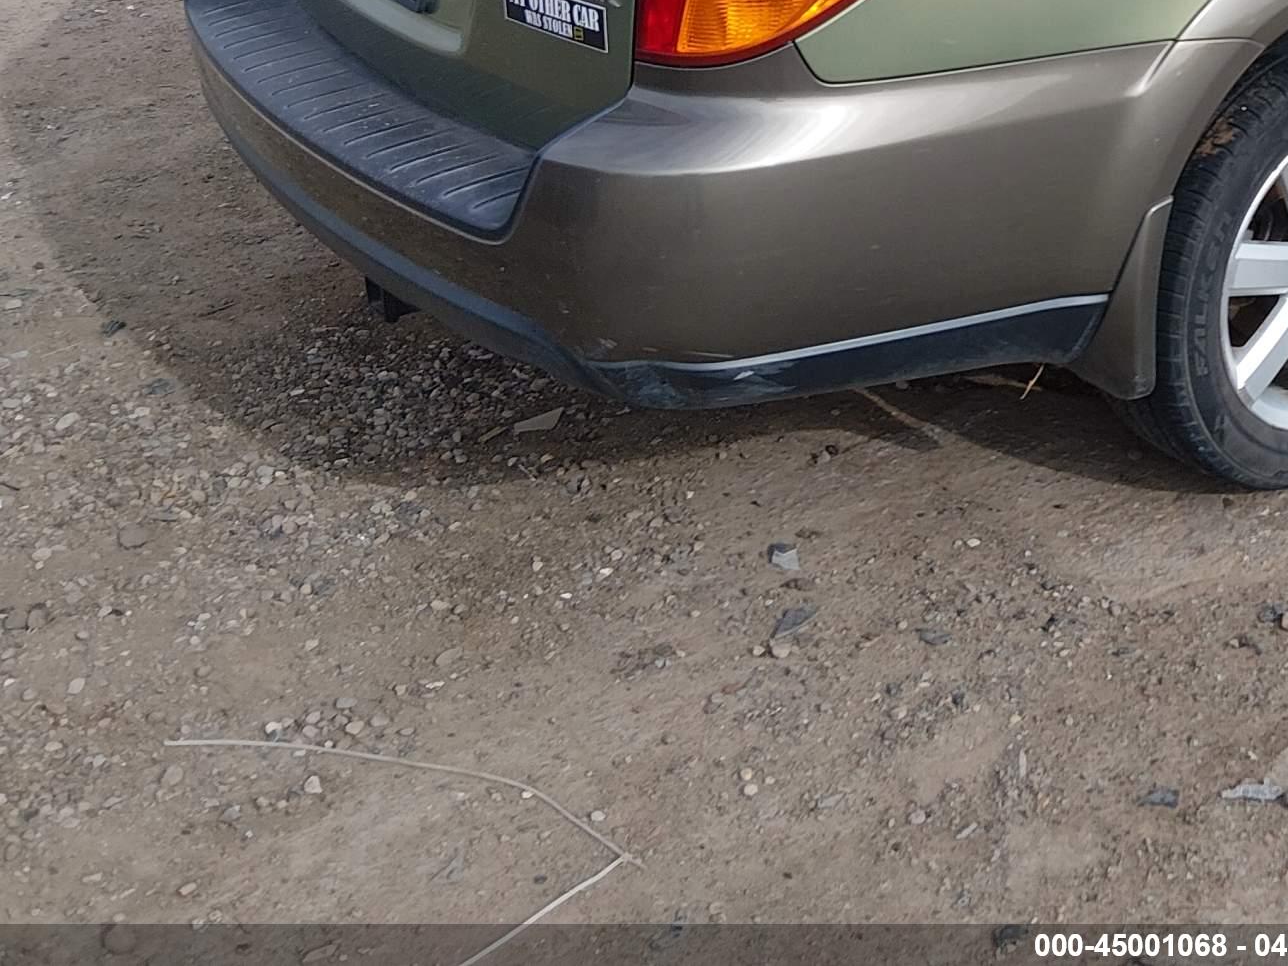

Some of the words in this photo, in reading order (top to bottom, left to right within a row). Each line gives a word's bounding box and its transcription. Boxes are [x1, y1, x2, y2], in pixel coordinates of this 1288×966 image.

[524, 9, 542, 27] WAS
[542, 15, 573, 38] STOLEN
[572, 4, 600, 32] CAR
